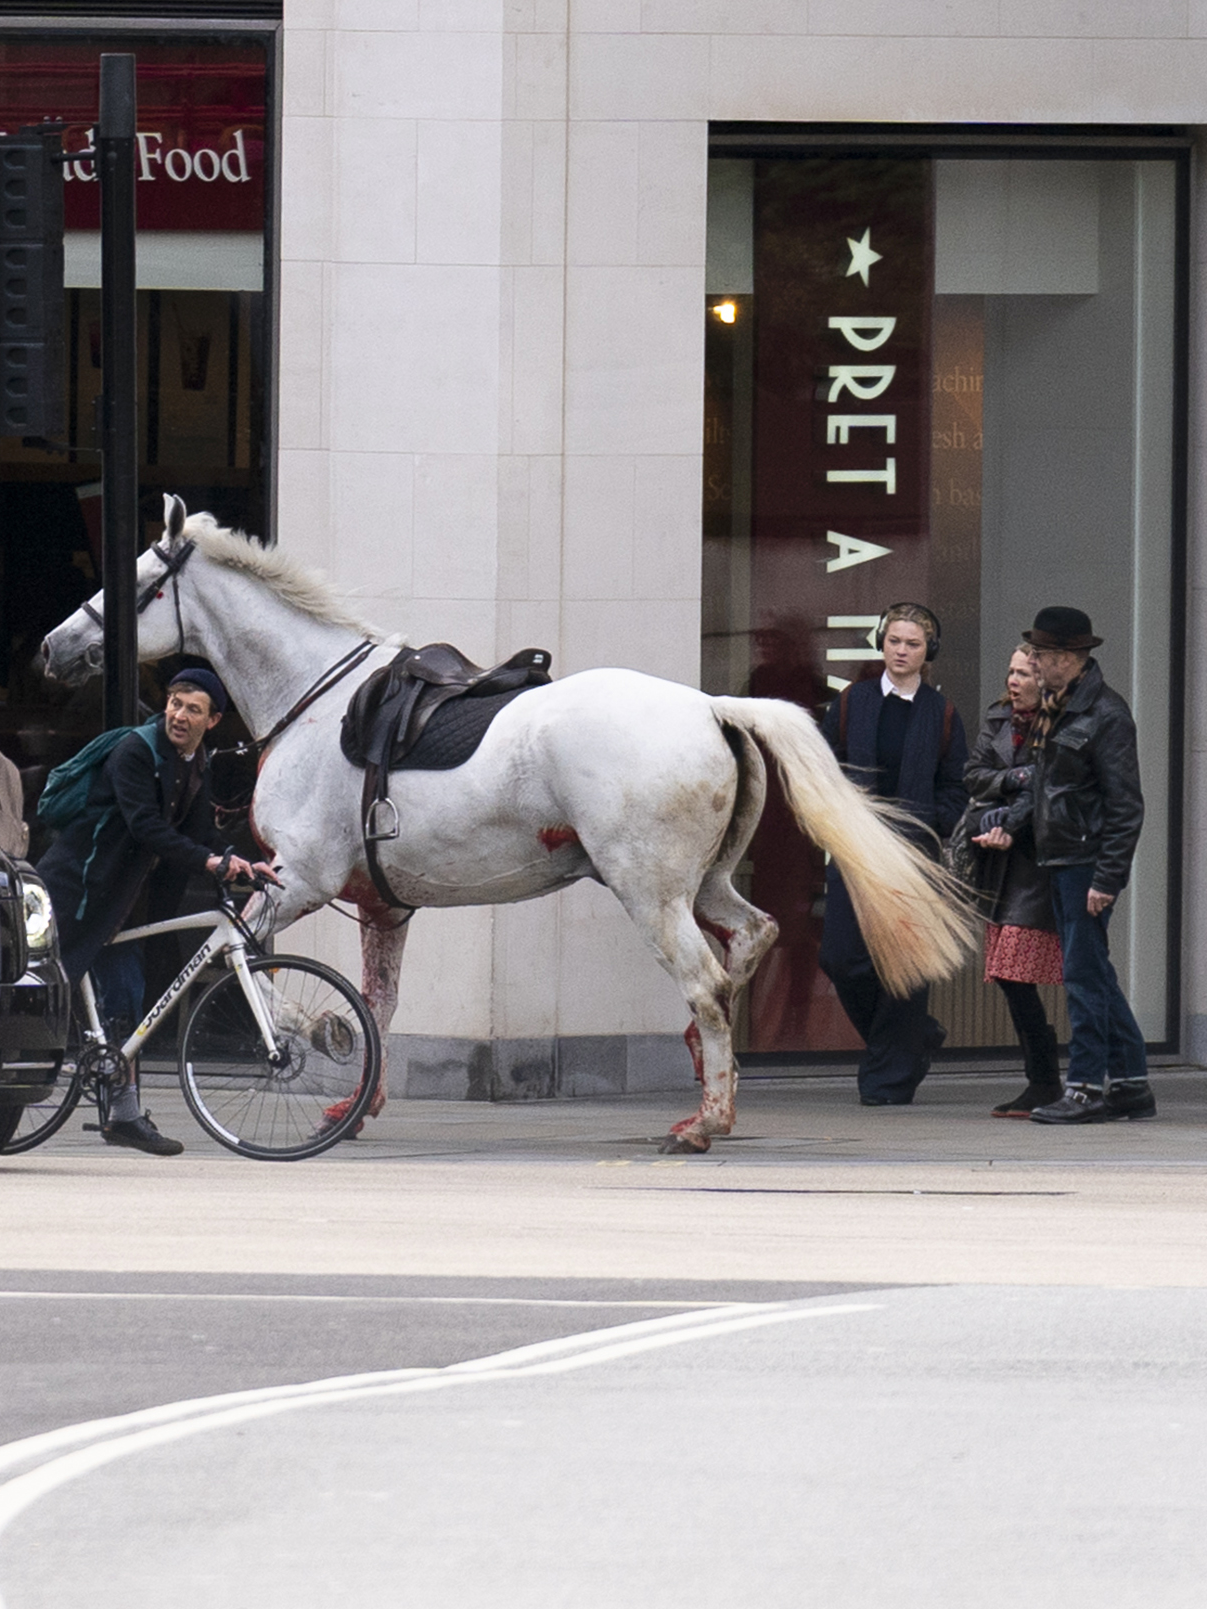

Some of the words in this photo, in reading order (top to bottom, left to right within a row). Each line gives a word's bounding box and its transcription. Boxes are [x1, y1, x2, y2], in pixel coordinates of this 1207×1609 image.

[135, 127, 252, 183] Food
[826, 315, 897, 495] PRET
[826, 529, 895, 574] A
